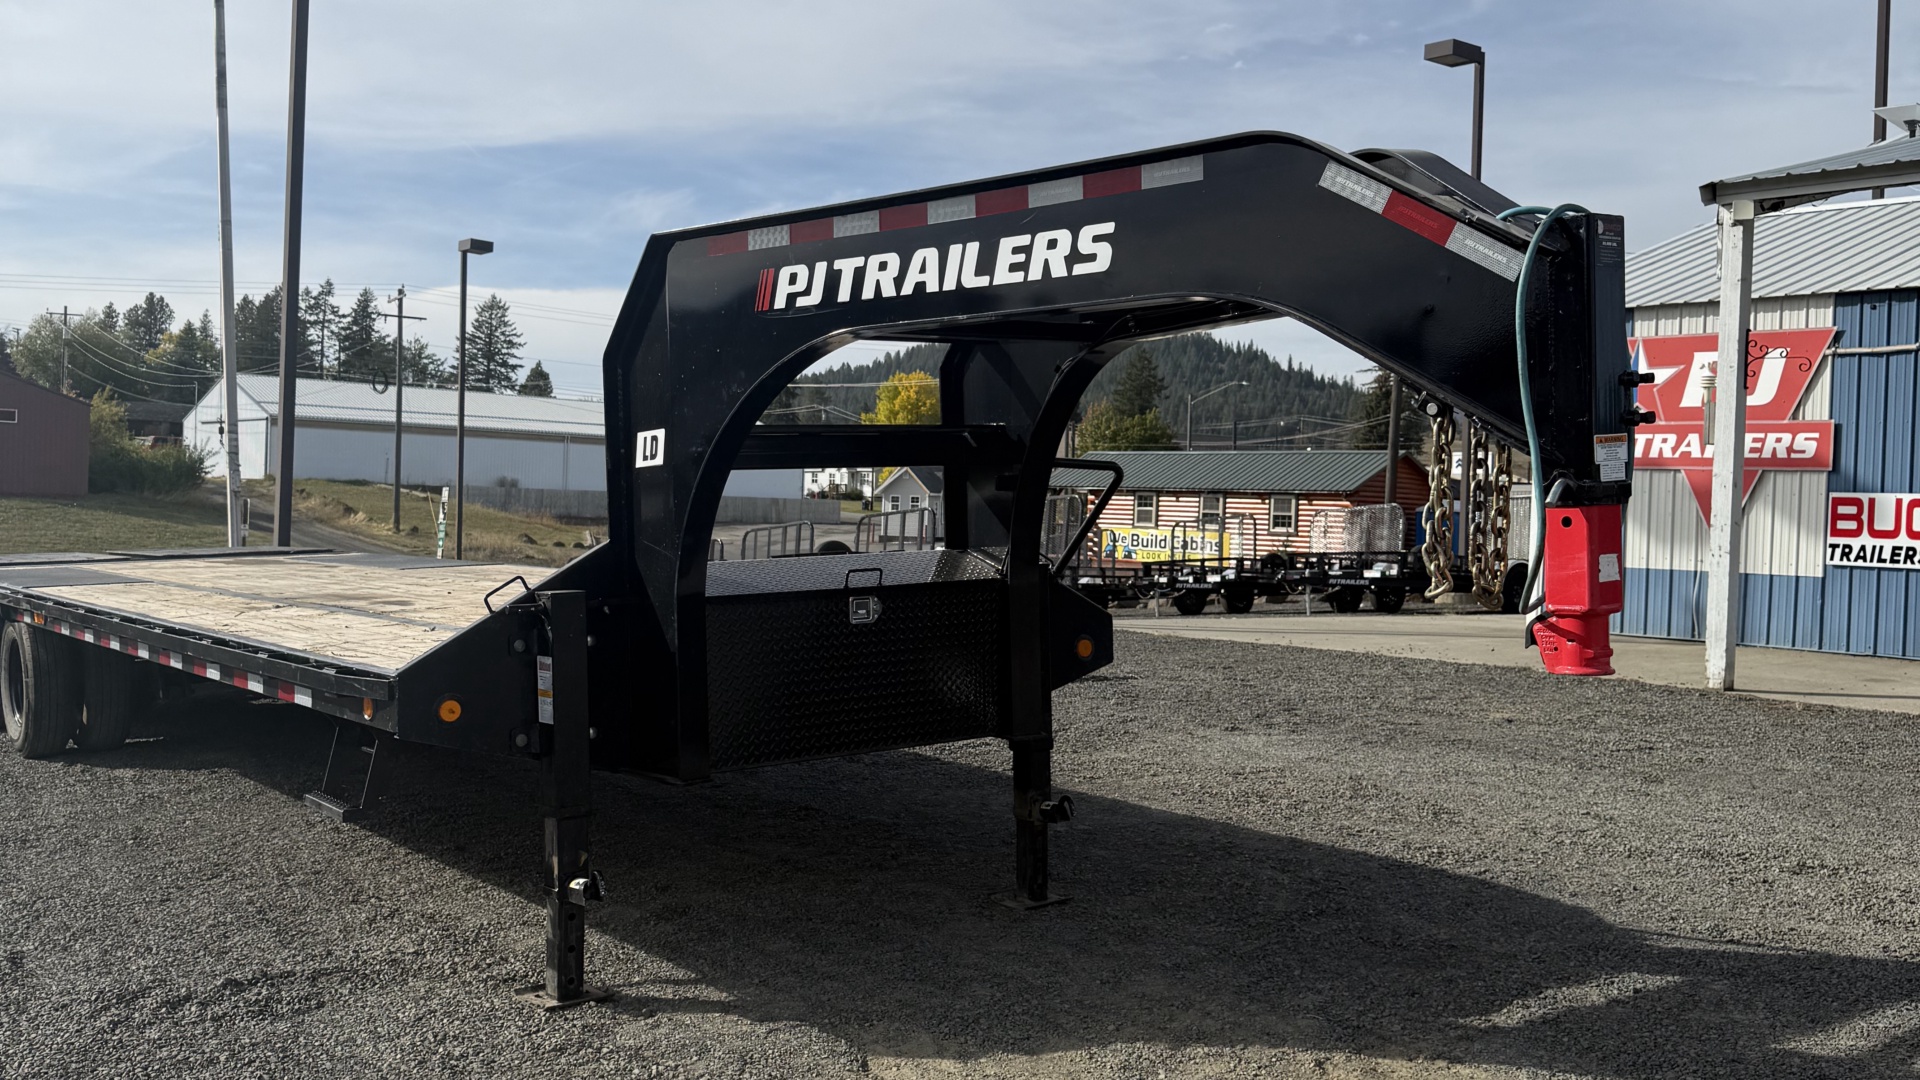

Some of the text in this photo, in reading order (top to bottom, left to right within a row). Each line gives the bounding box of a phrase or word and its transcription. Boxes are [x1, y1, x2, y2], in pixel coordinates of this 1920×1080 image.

[833, 221, 1116, 303] TRAILERS
[642, 434, 659, 462] LD
[1634, 432, 1820, 459] TRAERS
[1131, 533, 1168, 549] Build
[1141, 552, 1162, 560] LOOK
[1828, 543, 1920, 565] TRAILER
